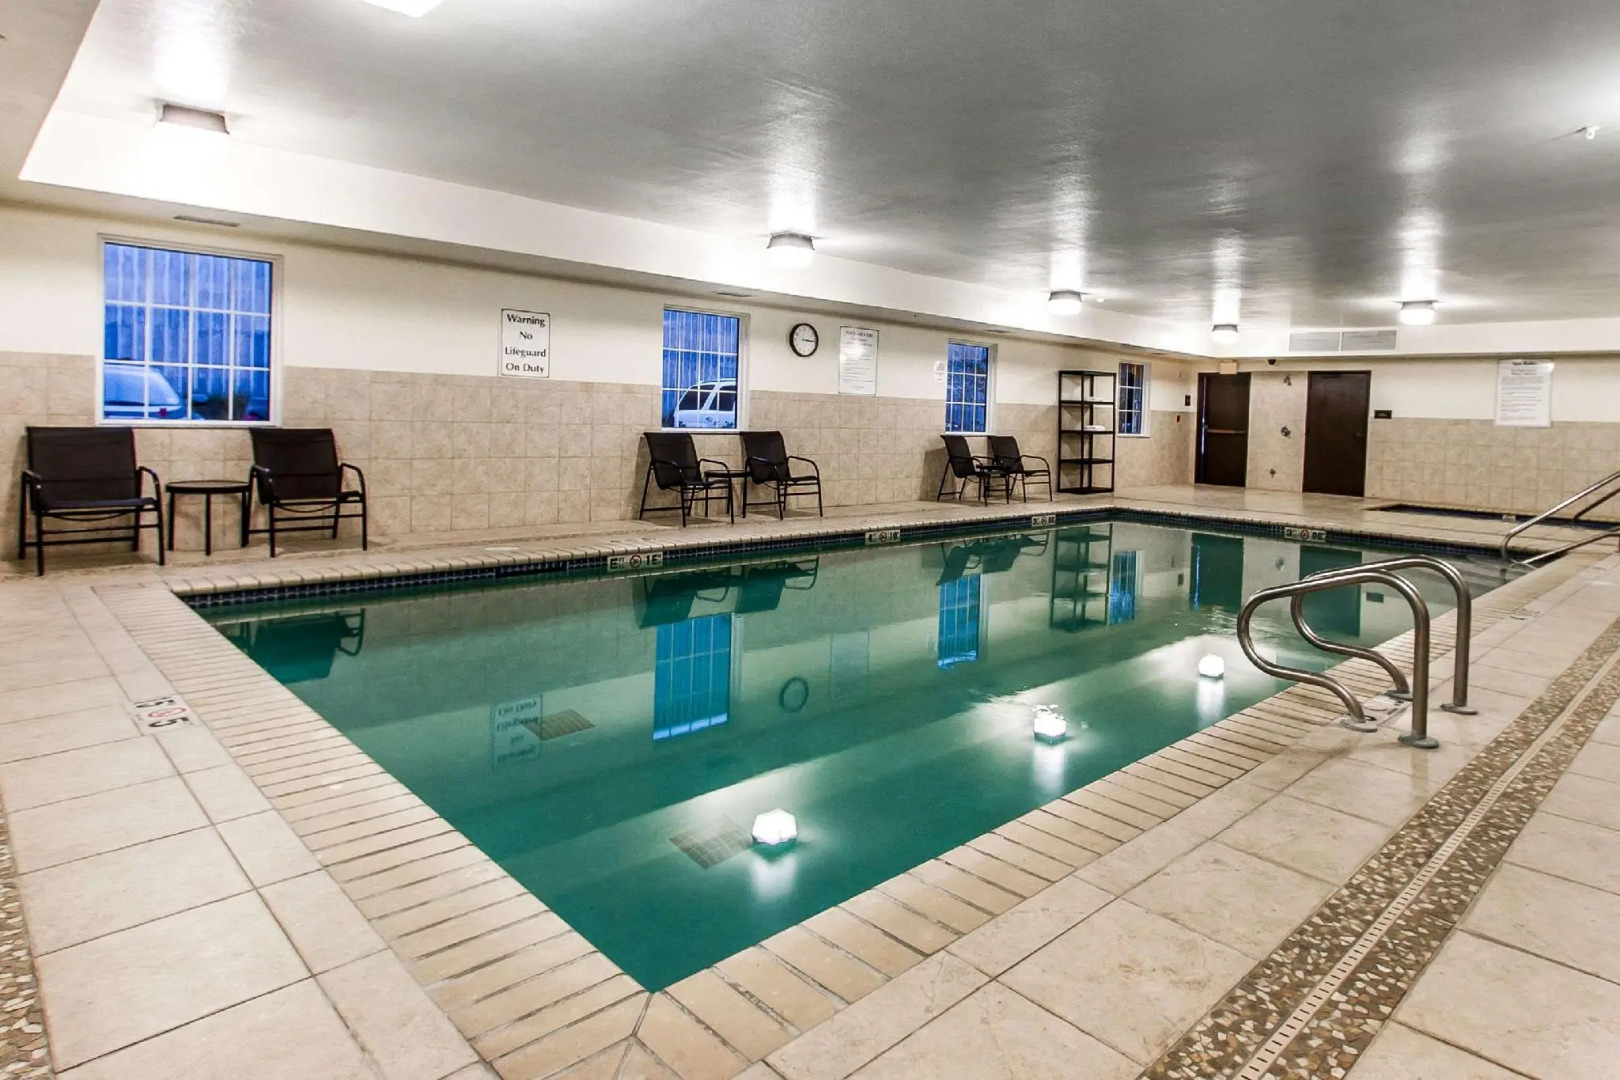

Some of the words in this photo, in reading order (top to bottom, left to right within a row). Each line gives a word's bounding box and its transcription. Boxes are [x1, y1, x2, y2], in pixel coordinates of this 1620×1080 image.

[506, 313, 546, 327] Warning
[519, 331, 532, 340] No
[505, 346, 546, 358] Lifeguard
[505, 362, 520, 371] On
[523, 363, 544, 374] Duty
